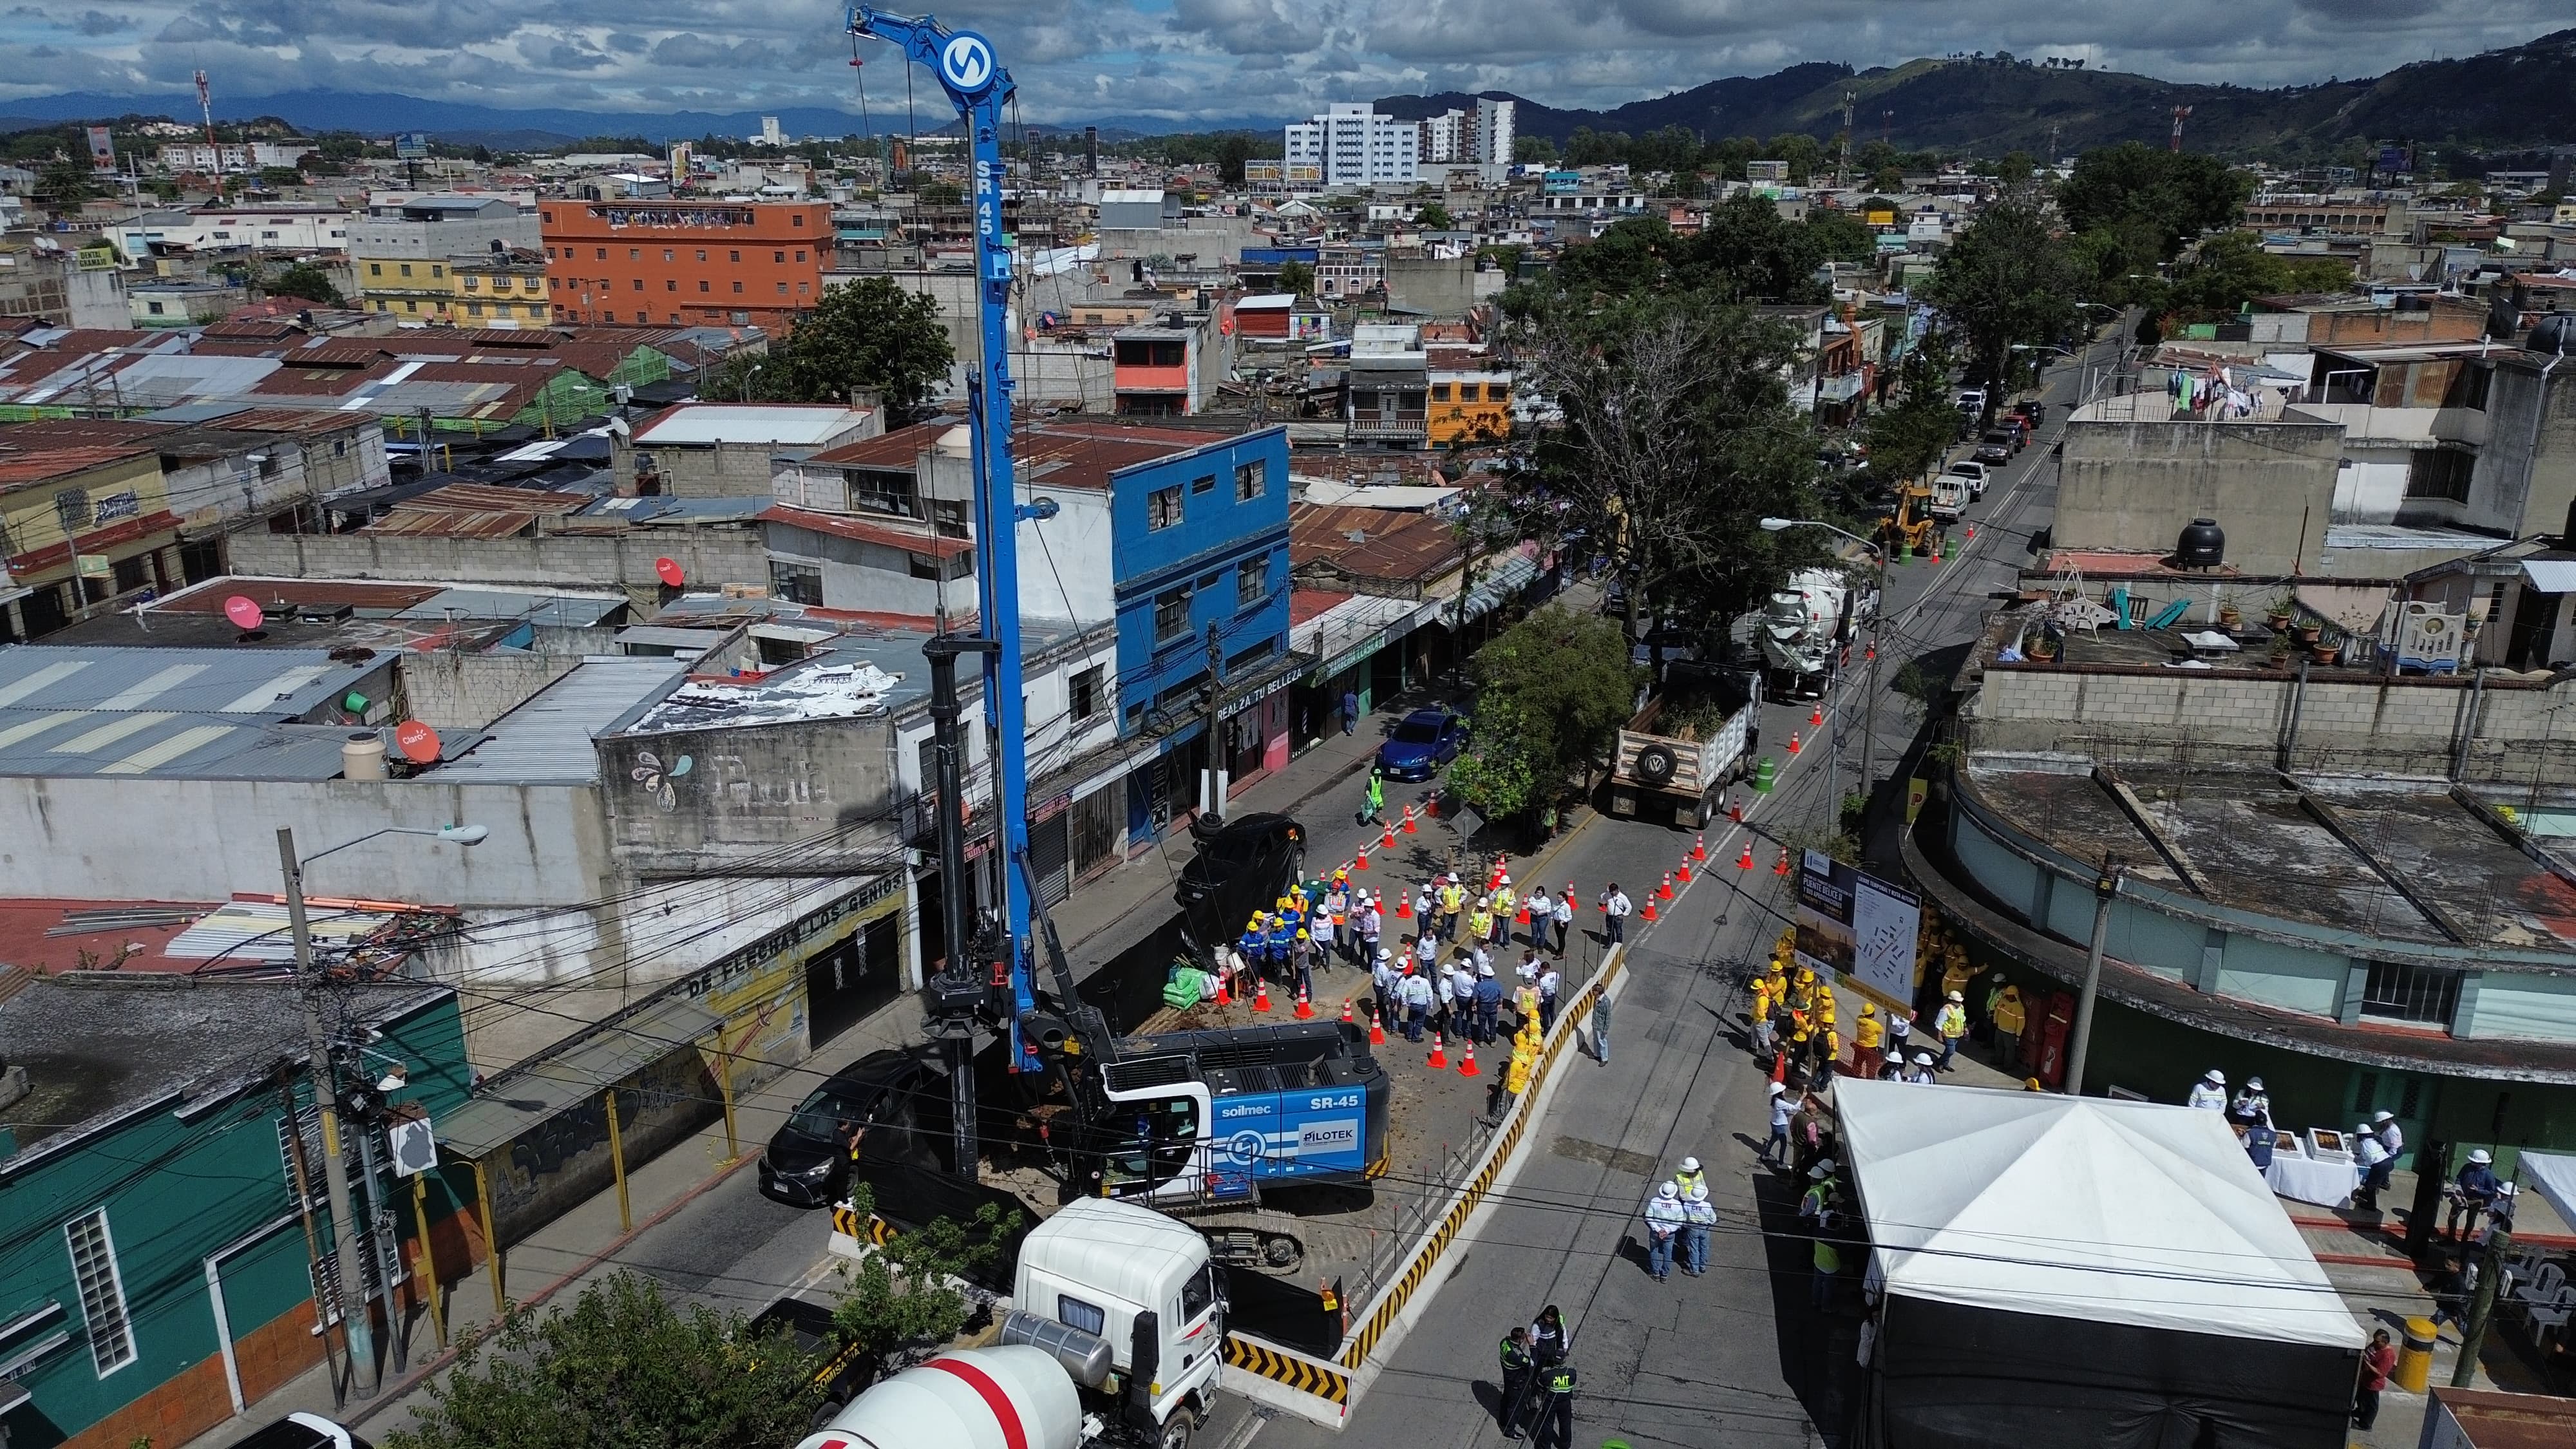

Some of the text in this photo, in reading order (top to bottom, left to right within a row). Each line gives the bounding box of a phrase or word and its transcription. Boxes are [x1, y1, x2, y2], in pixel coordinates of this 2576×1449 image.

[1264, 167, 1281, 178] 1702
[1306, 167, 1320, 178] 1702
[976, 160, 993, 235] SR 45
[1217, 668, 1302, 723] REALZA TU BELLEZA
[402, 734, 423, 744] Claro
[1803, 876, 1822, 893] PUENTE
[689, 972, 712, 998] DE
[810, 905, 840, 933] LOS
[849, 873, 903, 912] GENIOS
[1311, 1095, 1358, 1110] SR-45
[1222, 1105, 1271, 1117] soilmec
[1303, 1130, 1353, 1142] PILOTEK
[1553, 1375, 1570, 1387] PMT
